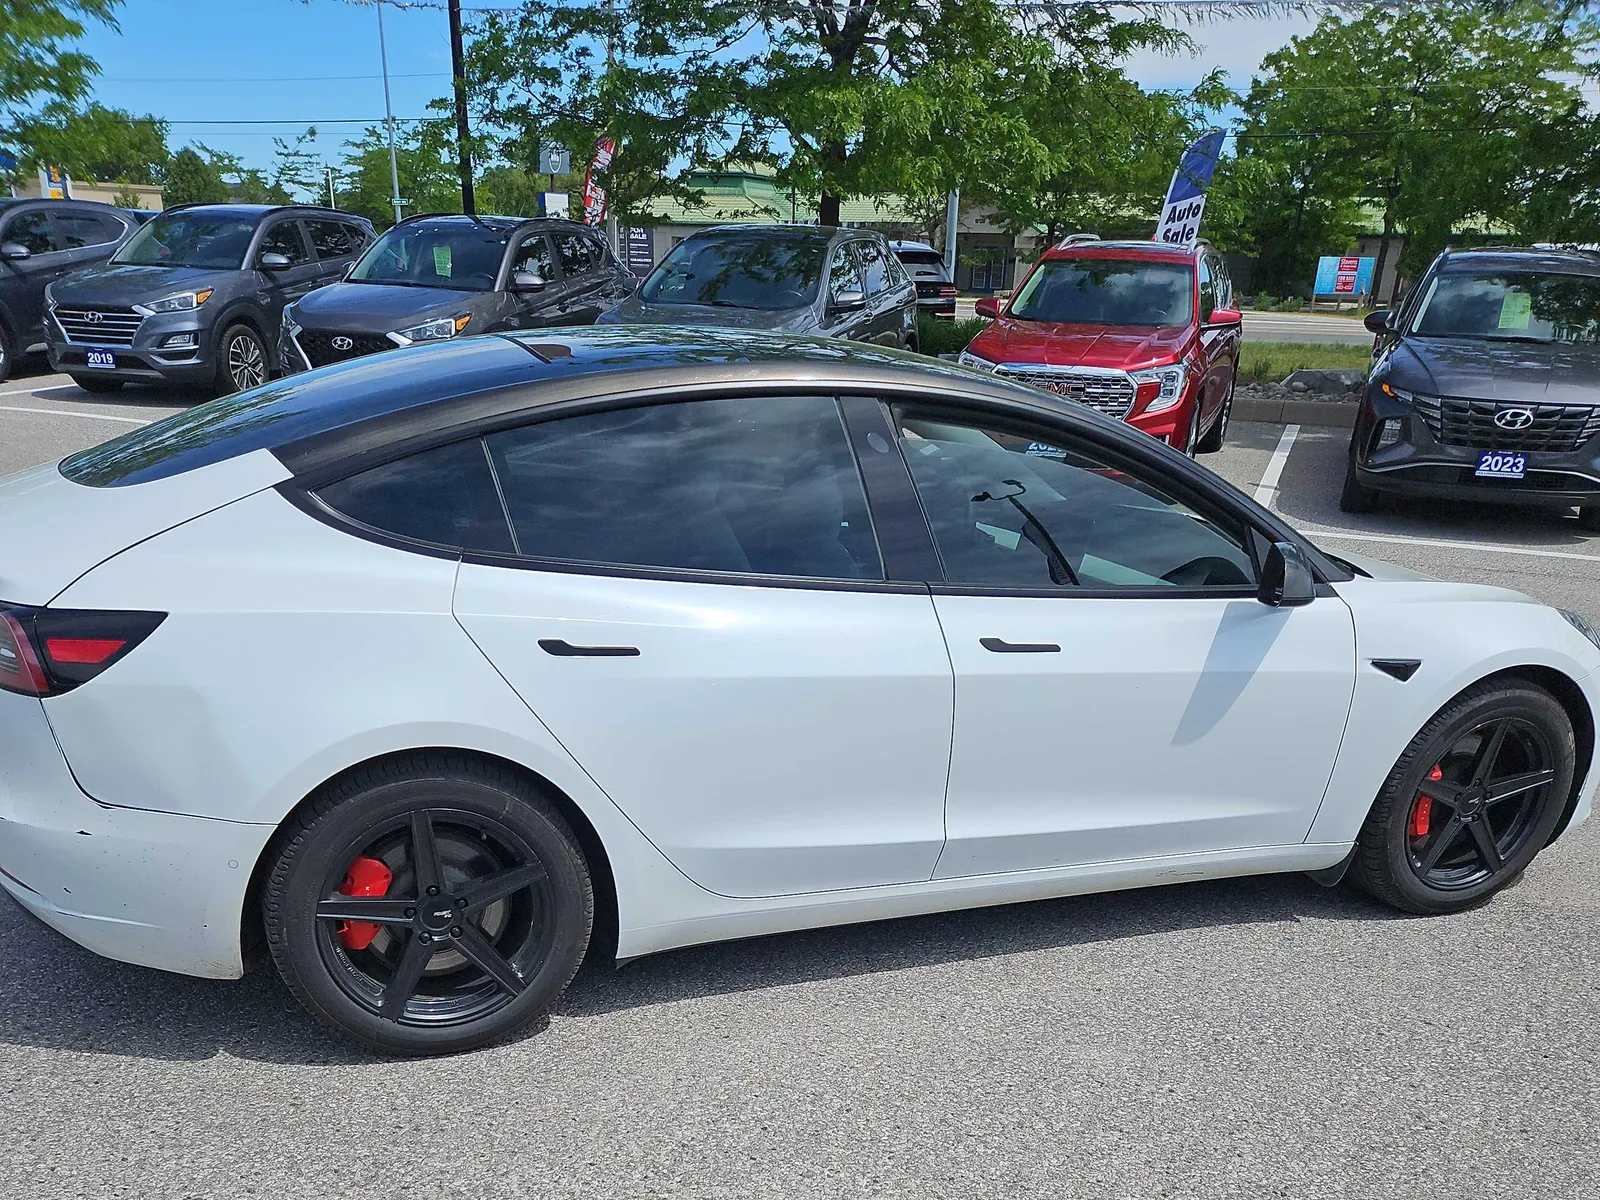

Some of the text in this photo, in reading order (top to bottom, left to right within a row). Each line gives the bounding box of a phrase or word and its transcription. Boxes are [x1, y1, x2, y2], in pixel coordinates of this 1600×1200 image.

[1164, 202, 1201, 225] Auto
[1163, 223, 1195, 243] Sale
[87, 352, 113, 364] 2019
[1479, 455, 1525, 473] 2023
